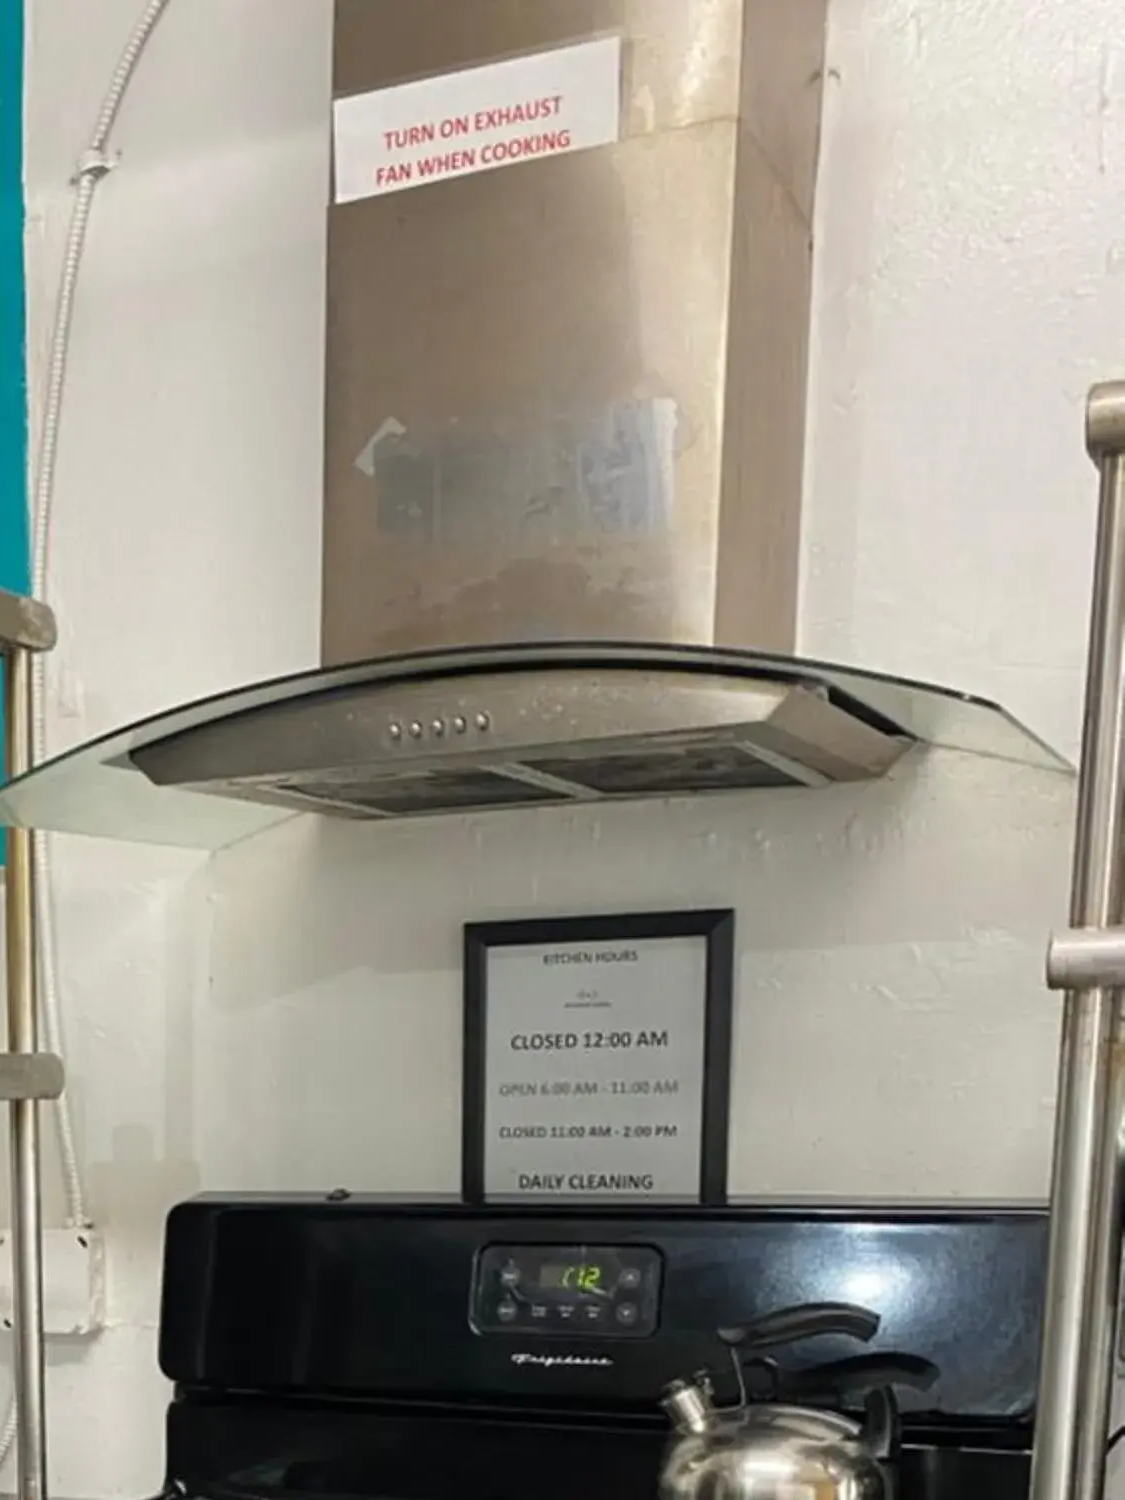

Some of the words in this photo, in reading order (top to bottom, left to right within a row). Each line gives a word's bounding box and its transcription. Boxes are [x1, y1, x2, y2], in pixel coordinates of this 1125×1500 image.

[384, 123, 434, 151] TURN
[441, 117, 468, 139] ON
[474, 95, 563, 131] EXHAUST
[375, 163, 411, 186] FAN
[418, 152, 475, 177] WHEN
[481, 130, 571, 163] COOKING
[543, 952, 592, 965] KITCHEN
[595, 949, 638, 963] HOURS
[511, 1033, 577, 1051] CLOSED
[584, 1032, 631, 1049] 12:00
[637, 1030, 668, 1047] AM
[499, 1084, 537, 1097] OPEN
[573, 1082, 598, 1095] AM
[612, 1081, 649, 1094] 11:00
[653, 1081, 678, 1094] AM
[499, 1126, 547, 1139] CLOSED
[551, 1125, 585, 1138] 11:00
[588, 1125, 612, 1137] AM
[623, 1125, 652, 1138] 2:00
[655, 1125, 677, 1138] PM
[519, 1174, 564, 1190] DAILY
[569, 1174, 654, 1190] CLEANING
